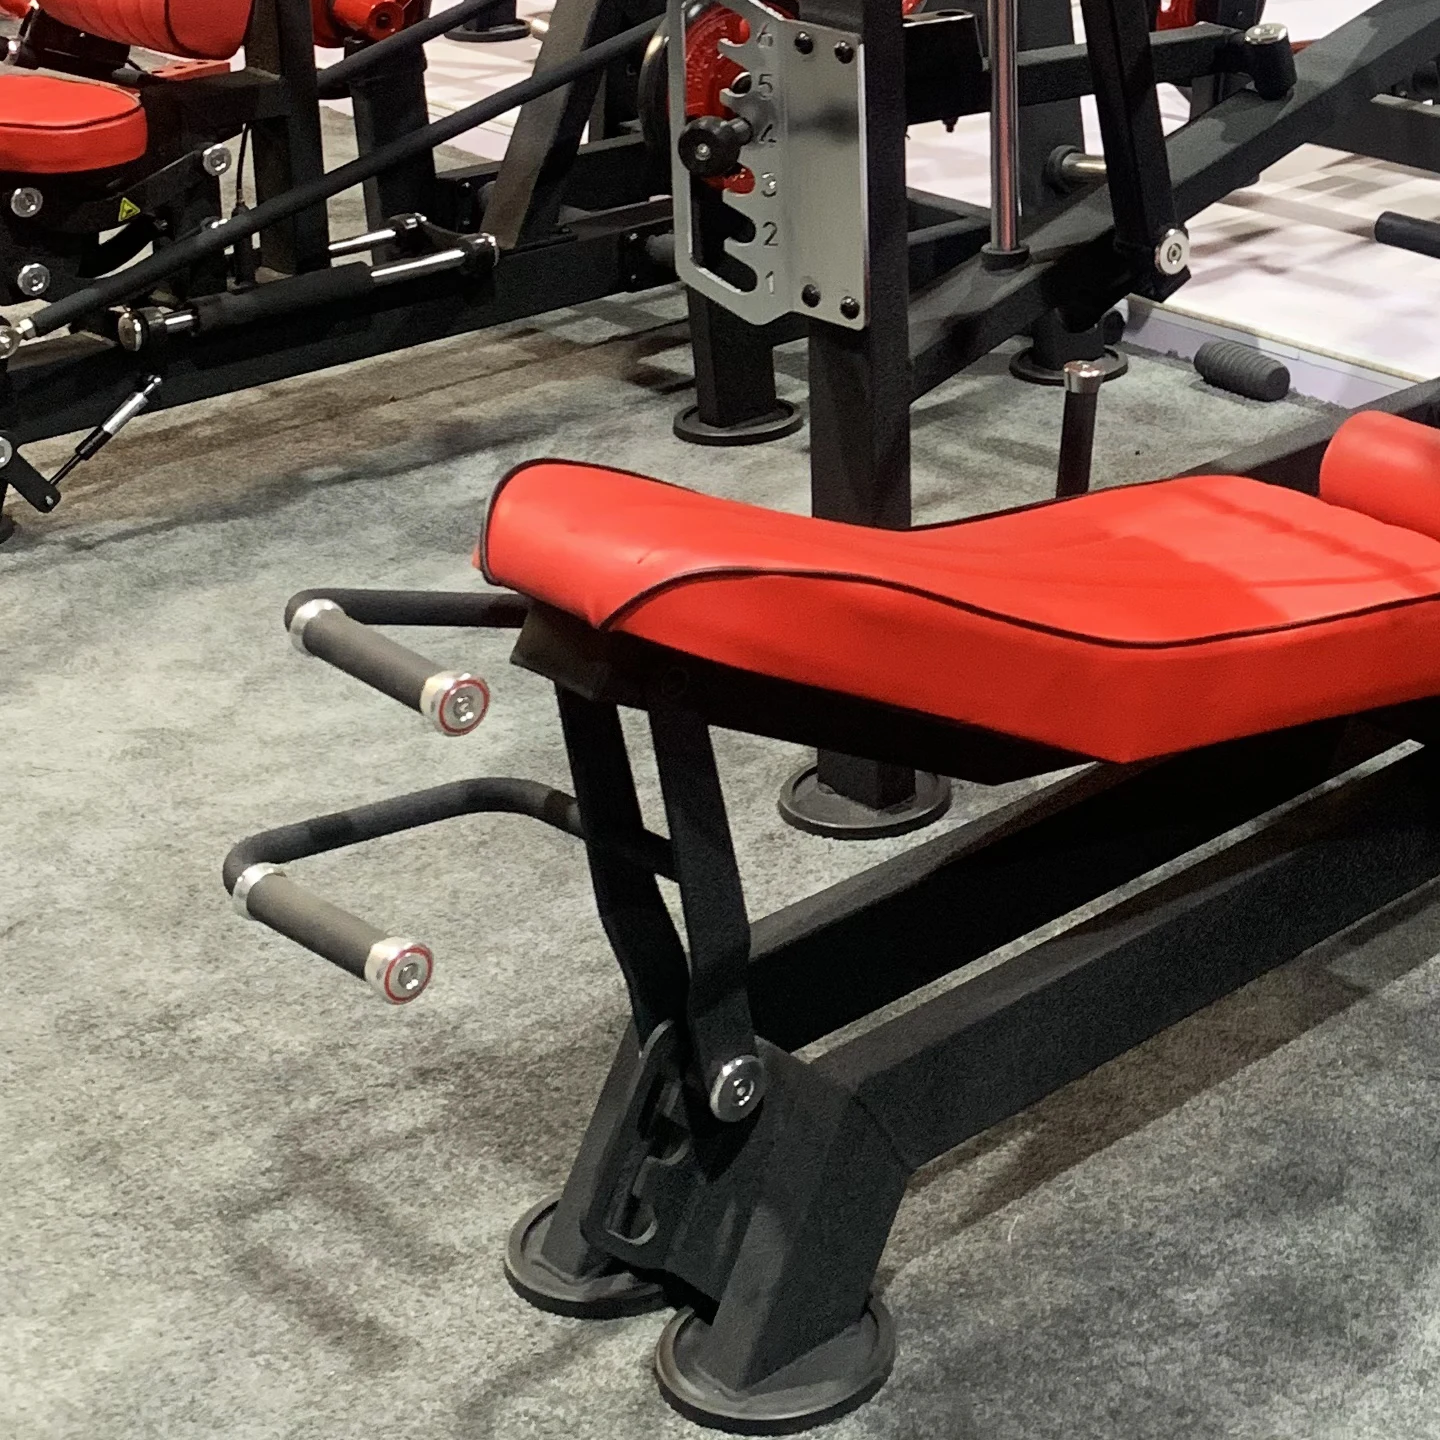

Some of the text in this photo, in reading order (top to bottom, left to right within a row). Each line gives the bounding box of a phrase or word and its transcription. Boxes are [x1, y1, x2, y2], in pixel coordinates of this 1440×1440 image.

[756, 24, 773, 48] 6
[758, 74, 773, 98] 5
[759, 124, 777, 143] 4
[762, 172, 777, 197] 3
[763, 222, 779, 246] 2
[765, 271, 774, 294] 1
